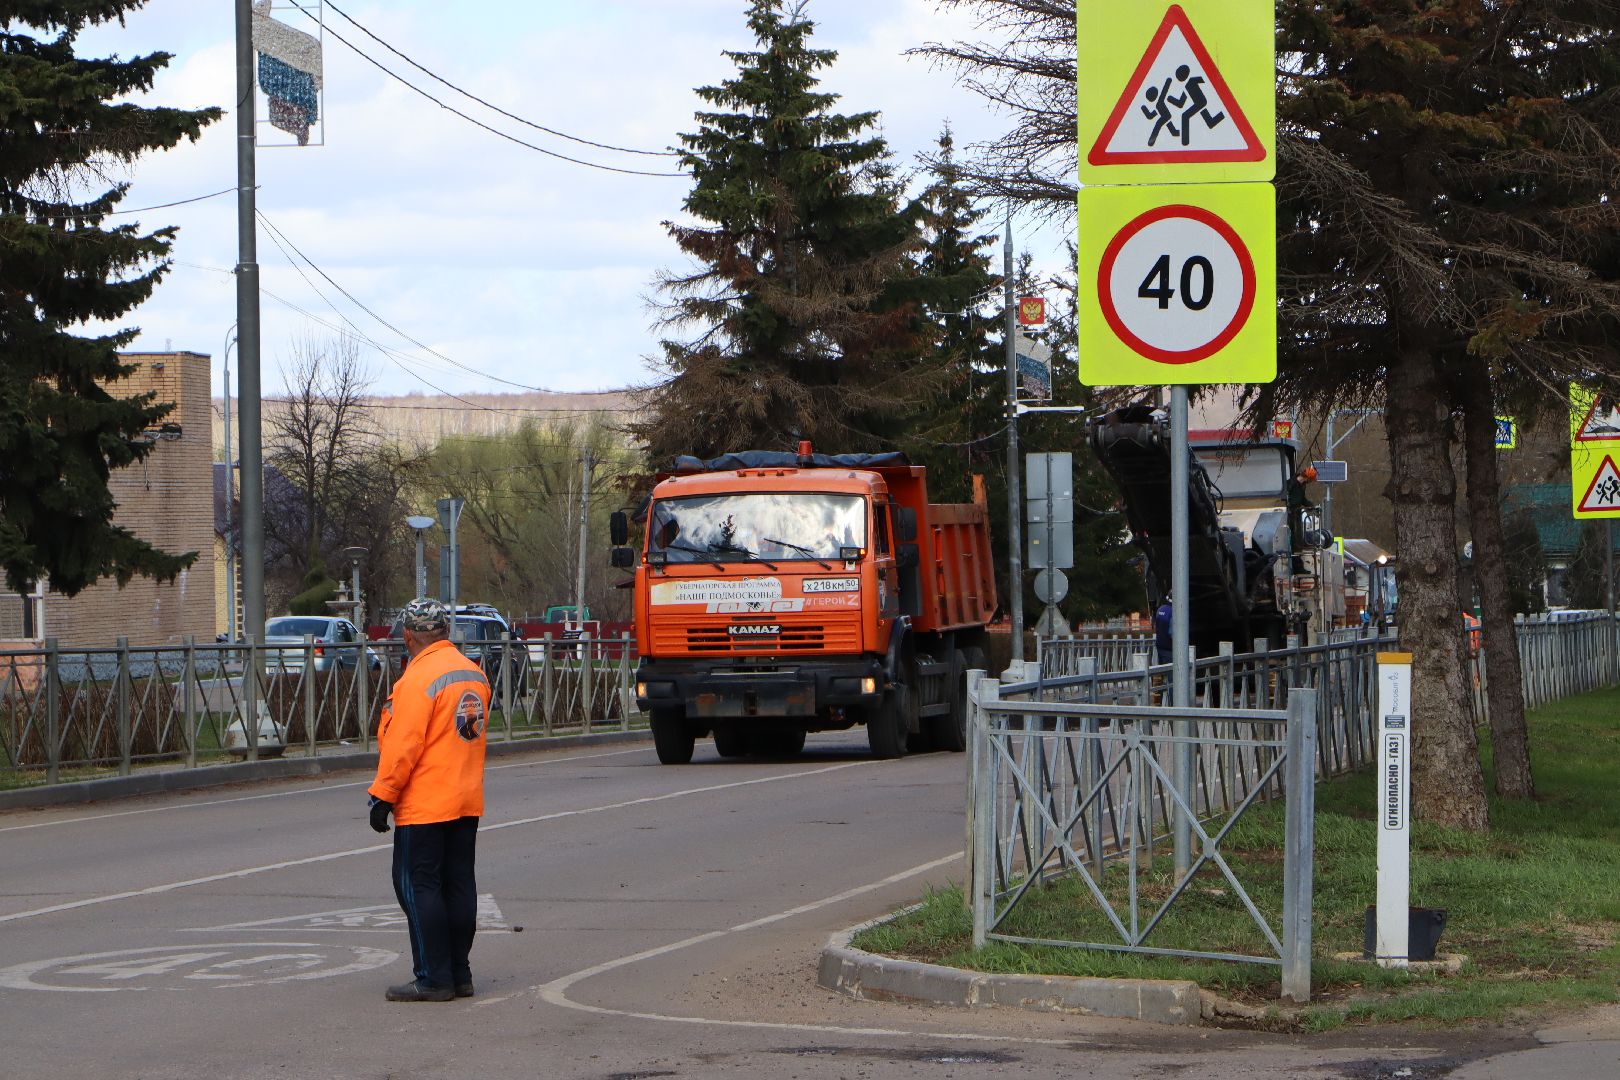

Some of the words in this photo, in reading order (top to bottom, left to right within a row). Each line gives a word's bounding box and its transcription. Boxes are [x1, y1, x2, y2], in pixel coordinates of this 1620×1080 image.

[1138, 255, 1214, 311] 40
[675, 582, 736, 590] ГУБЕРНАТОРСКАЯ
[738, 581, 781, 589] ПРОГРАММА
[728, 625, 780, 634] KAMAZ
[56, 951, 327, 980] 40
